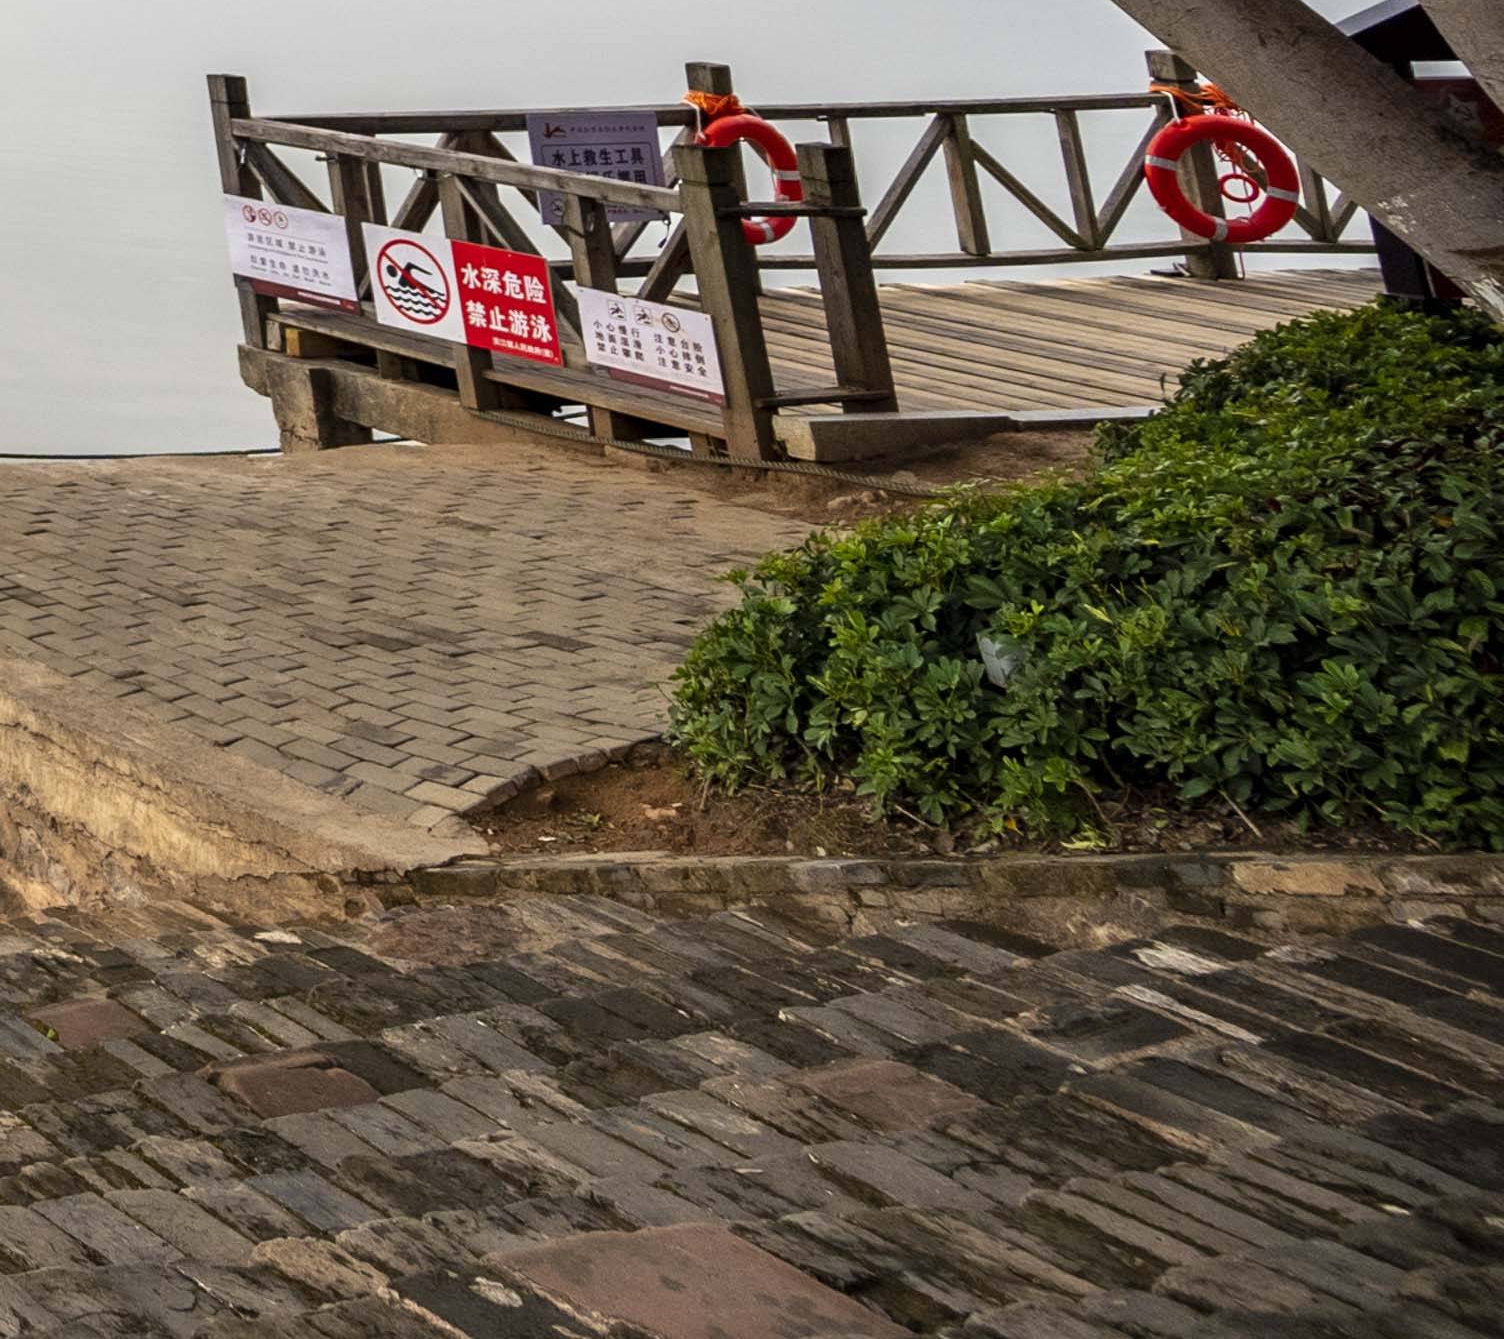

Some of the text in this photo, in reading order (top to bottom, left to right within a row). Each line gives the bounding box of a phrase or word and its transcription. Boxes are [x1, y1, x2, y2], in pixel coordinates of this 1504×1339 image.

[551, 147, 645, 167] 水上救生工具
[461, 262, 547, 304] 水深危险
[466, 299, 553, 343] 禁止游泳
